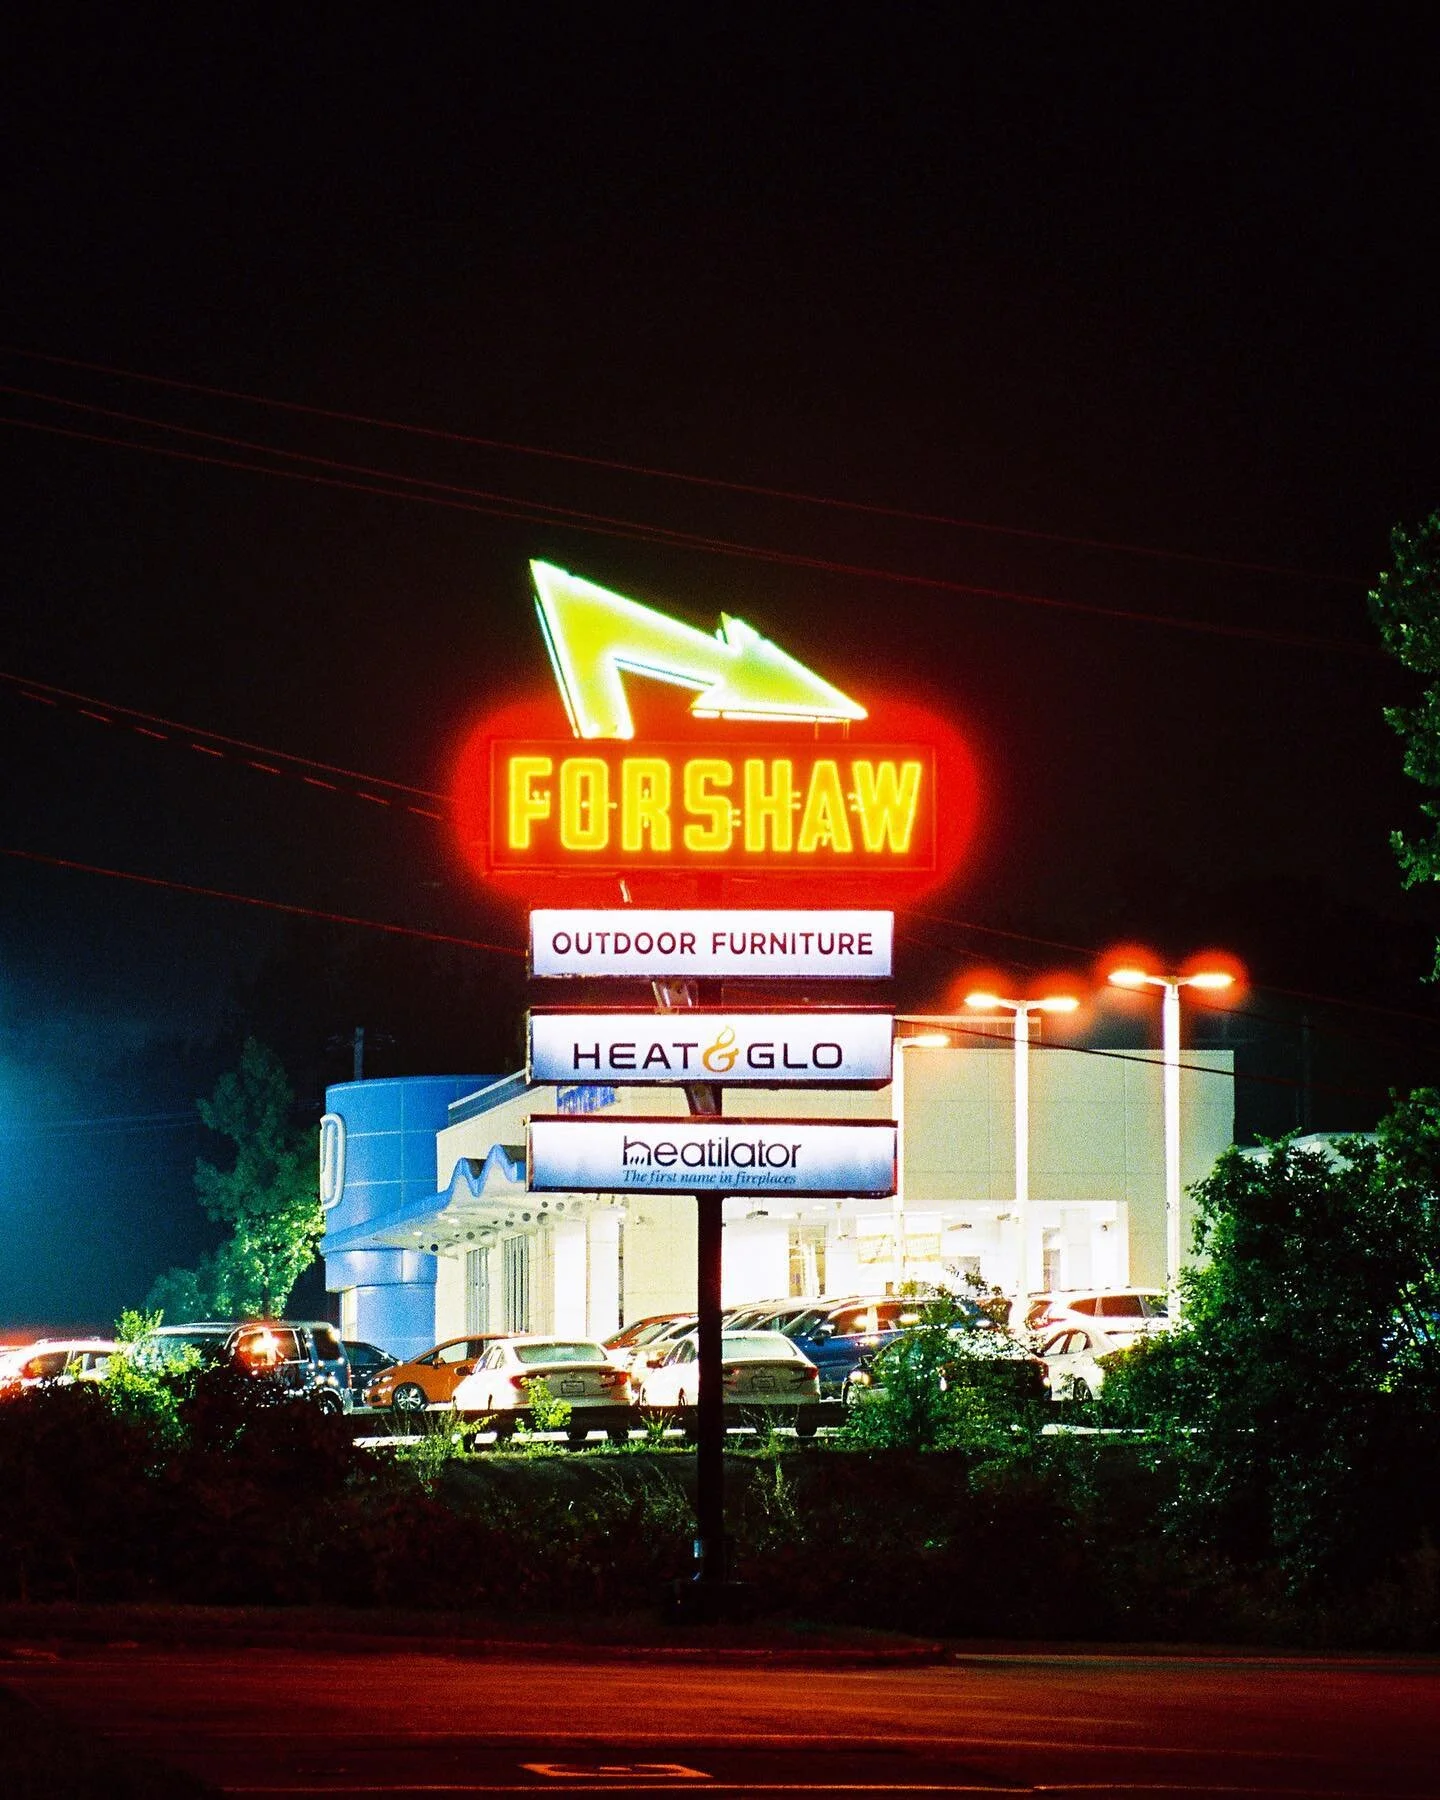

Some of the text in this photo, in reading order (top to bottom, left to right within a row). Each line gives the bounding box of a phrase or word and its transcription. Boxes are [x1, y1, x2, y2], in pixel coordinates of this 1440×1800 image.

[508, 757, 923, 853] FORSHAW
[551, 931, 873, 956] OUTDOOR FURNITURE
[622, 1135, 802, 1168] heatilator
[623, 1169, 797, 1187] The first name in fireplaces
